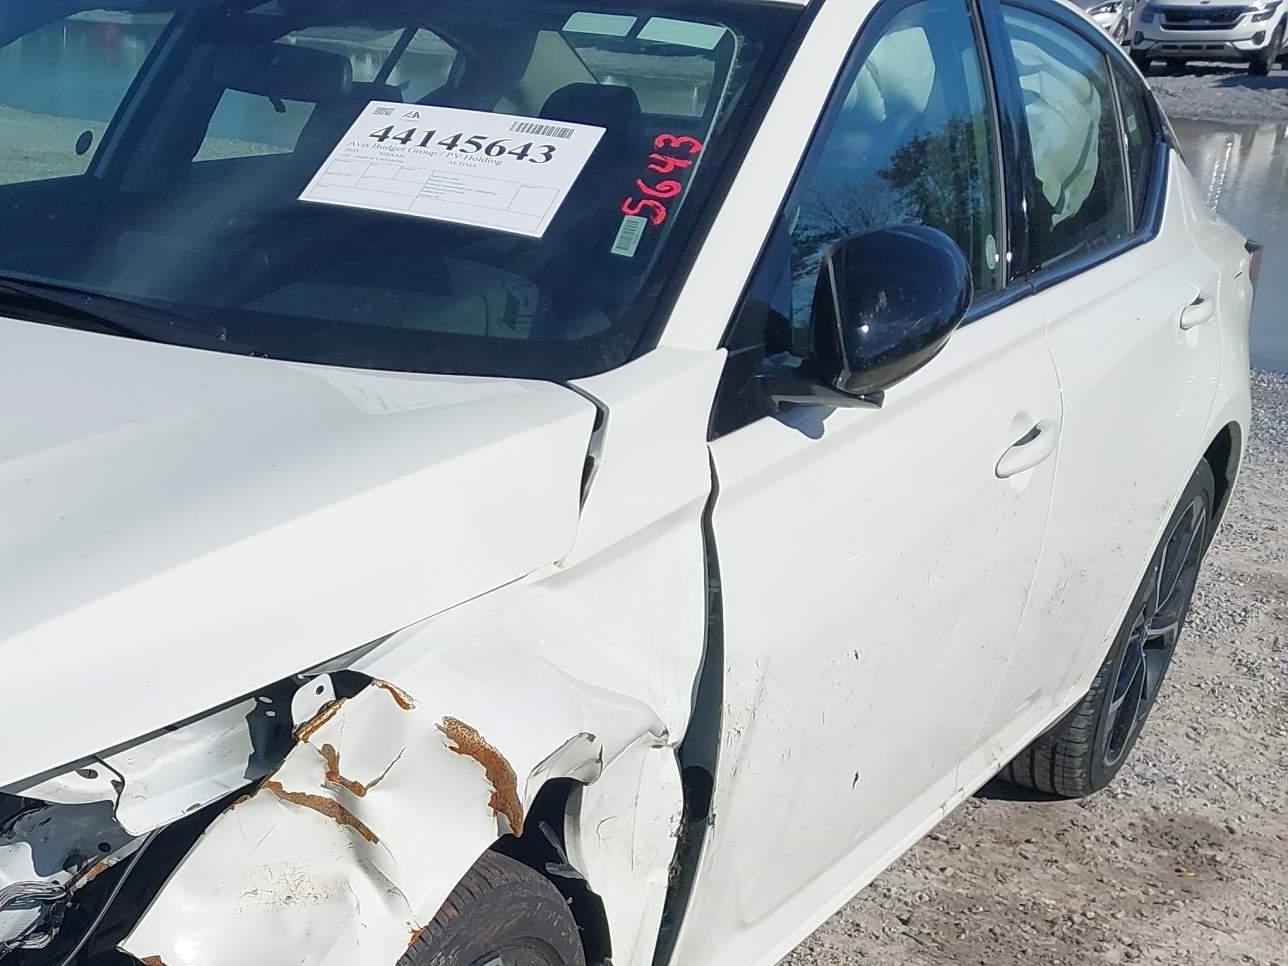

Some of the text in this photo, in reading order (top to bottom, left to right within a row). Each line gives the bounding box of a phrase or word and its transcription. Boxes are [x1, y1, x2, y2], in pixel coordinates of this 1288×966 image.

[368, 124, 557, 164] 44145643
[372, 142, 406, 152] Budget
[408, 147, 438, 157] Group
[447, 152, 462, 160] PV
[464, 154, 503, 166] Holding
[620, 132, 703, 226] 5643
